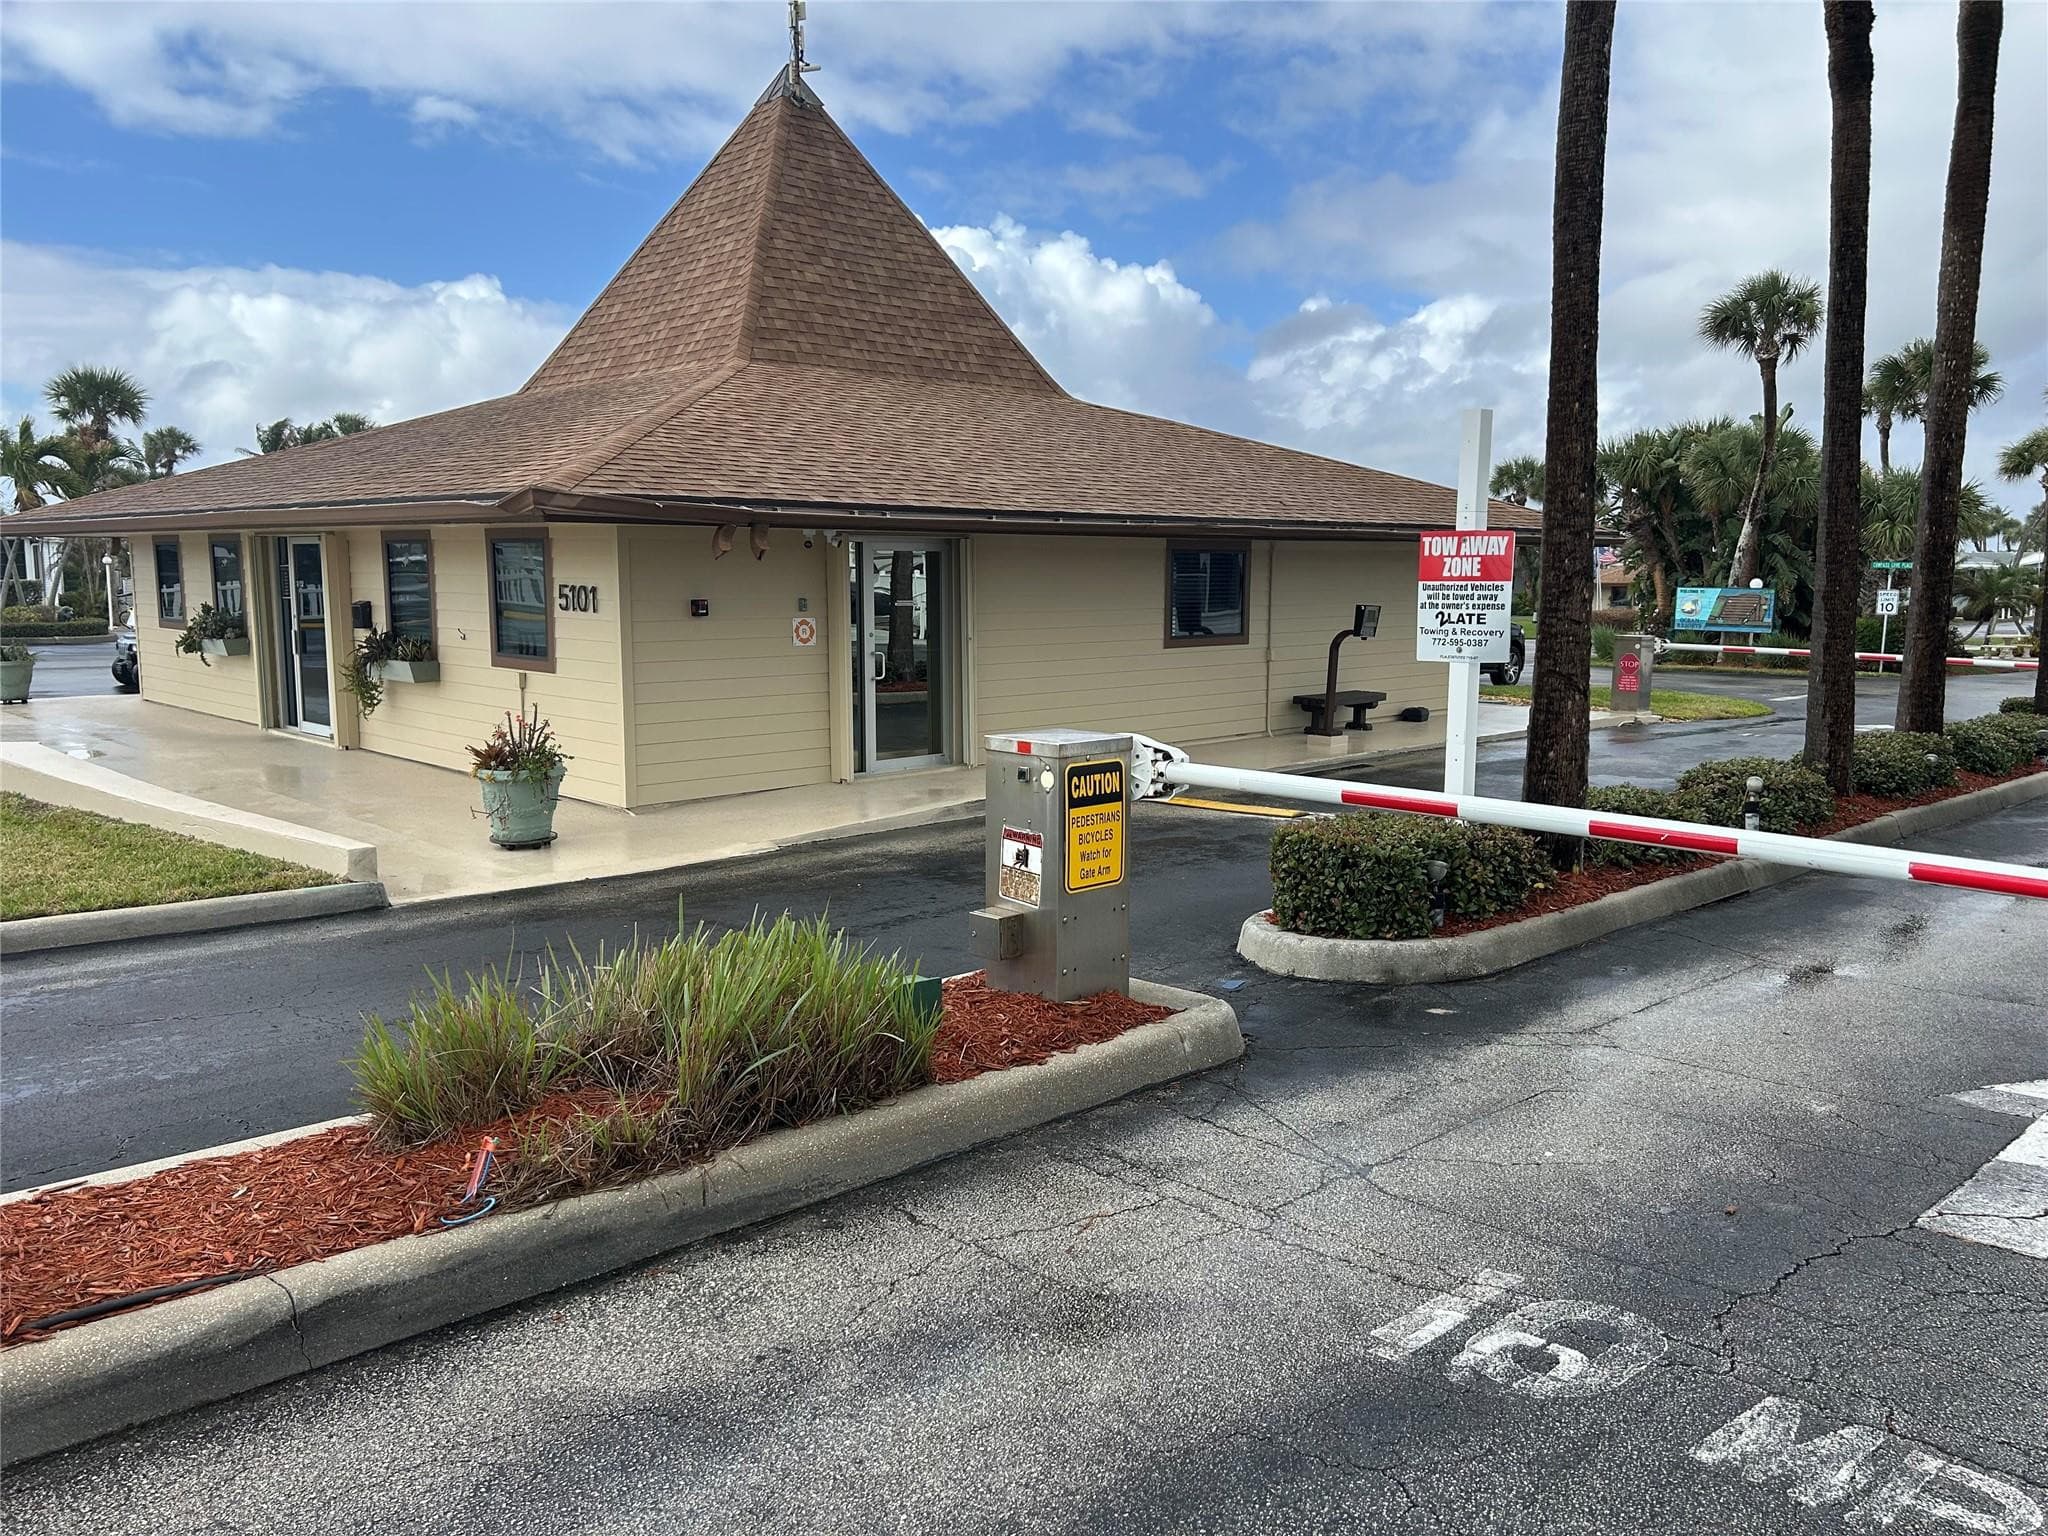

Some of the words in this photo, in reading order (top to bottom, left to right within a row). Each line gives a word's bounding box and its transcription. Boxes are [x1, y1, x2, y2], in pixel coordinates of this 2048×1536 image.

[1423, 536, 1457, 556] TOW
[1460, 536, 1509, 556] AWAY
[1442, 557, 1481, 577] ZONE
[1422, 583, 1468, 592] Unauthorized
[1470, 583, 1505, 592] Vehicles
[558, 584, 598, 613] 5101
[1427, 592, 1440, 601] will
[1441, 592, 1450, 601] be
[1452, 592, 1475, 601] towed
[1476, 593, 1498, 602] away
[1420, 602, 1428, 610] at
[1428, 602, 1439, 610] the
[1441, 602, 1470, 610] owner's
[1471, 602, 1506, 611] expense
[1880, 602, 1894, 612] 10
[1435, 611, 1487, 627] 2LATE
[1419, 626, 1449, 637] Towing
[1451, 628, 1457, 636] &
[1460, 627, 1505, 639] Recovery
[1431, 637, 1489, 647] 772-595-0387
[1071, 771, 1120, 799] CAUTION
[1071, 810, 1121, 829] PEDESTRIANS
[1078, 828, 1114, 846] BICYCLES
[1080, 849, 1101, 862] Watch
[1102, 847, 1112, 858] for
[1080, 868, 1095, 880] Gate
[1097, 864, 1111, 876] Arm
